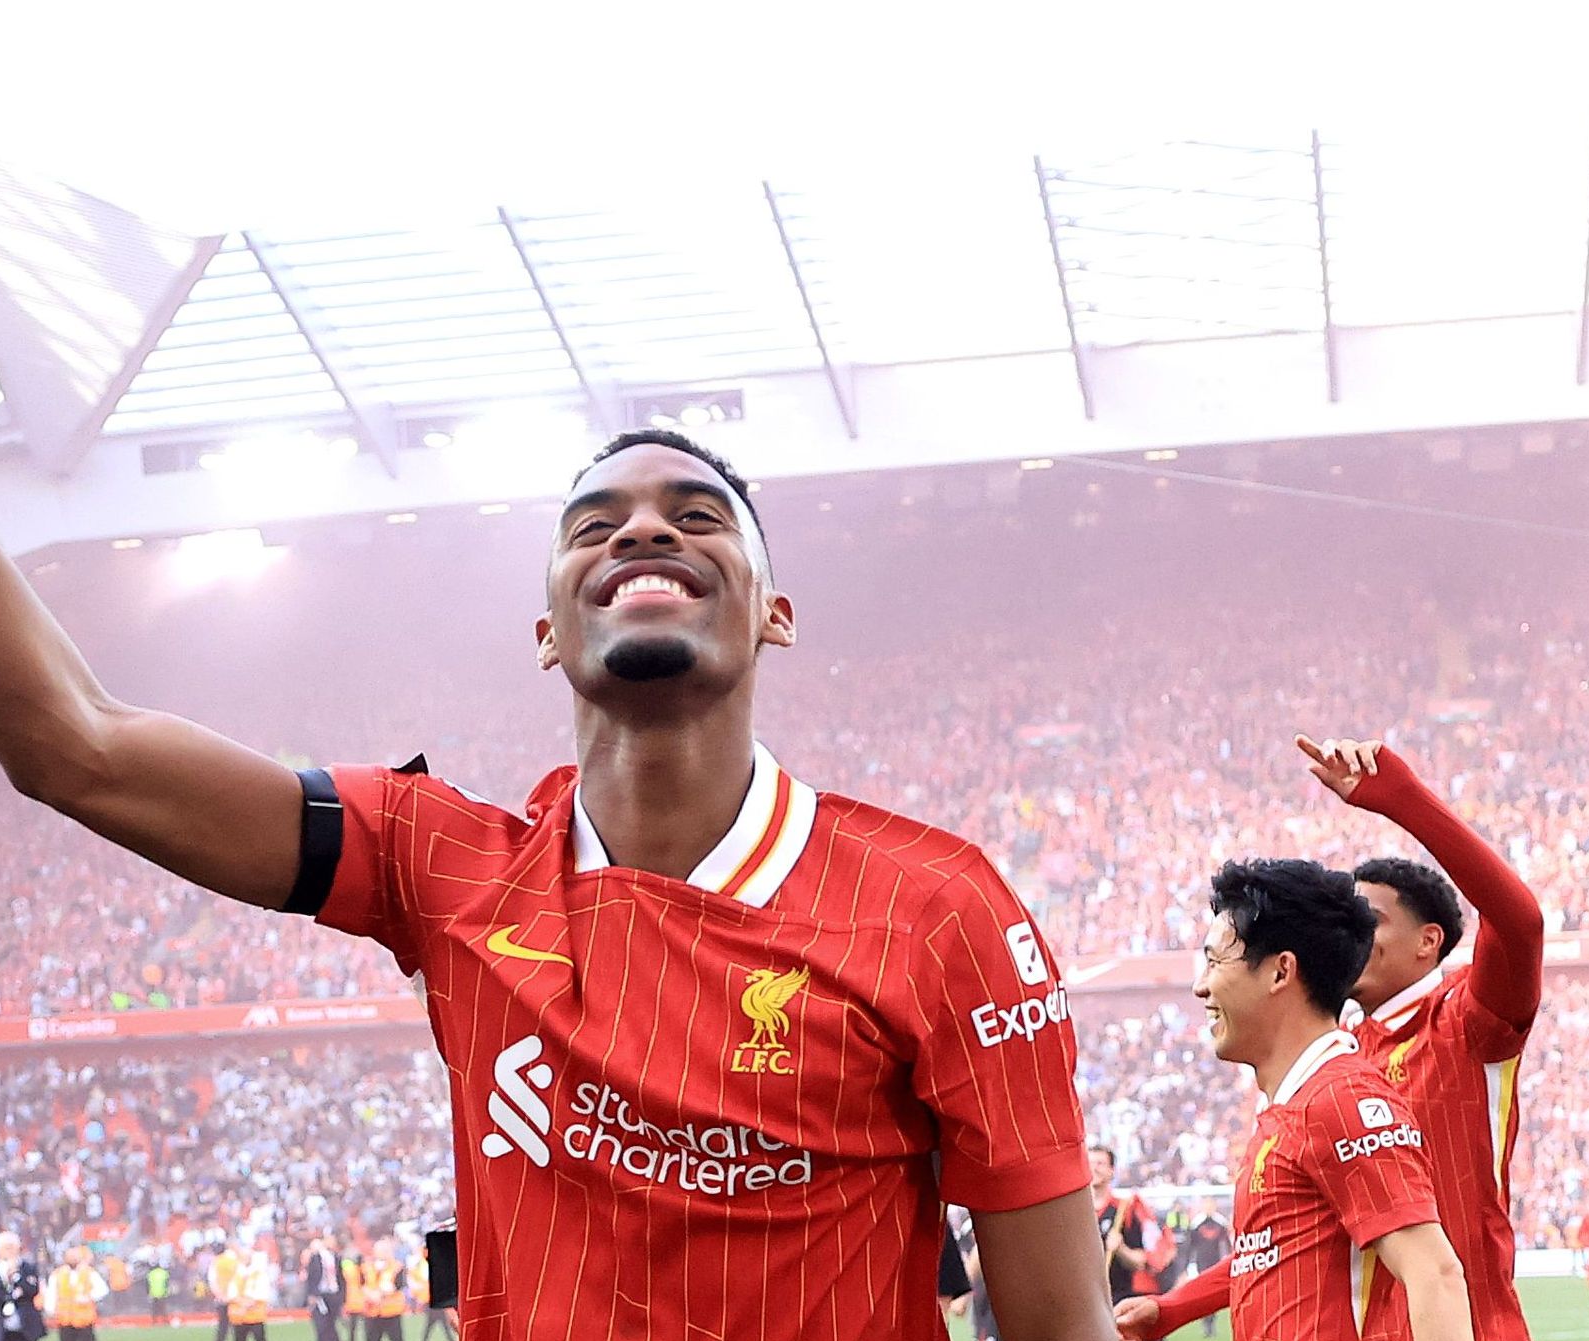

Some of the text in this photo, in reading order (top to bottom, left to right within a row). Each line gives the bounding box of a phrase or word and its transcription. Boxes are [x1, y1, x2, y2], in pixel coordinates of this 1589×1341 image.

[731, 1049, 795, 1075] L.F.C.
[564, 1123, 812, 1196] chartered
[1335, 1124, 1423, 1163] Expedia
